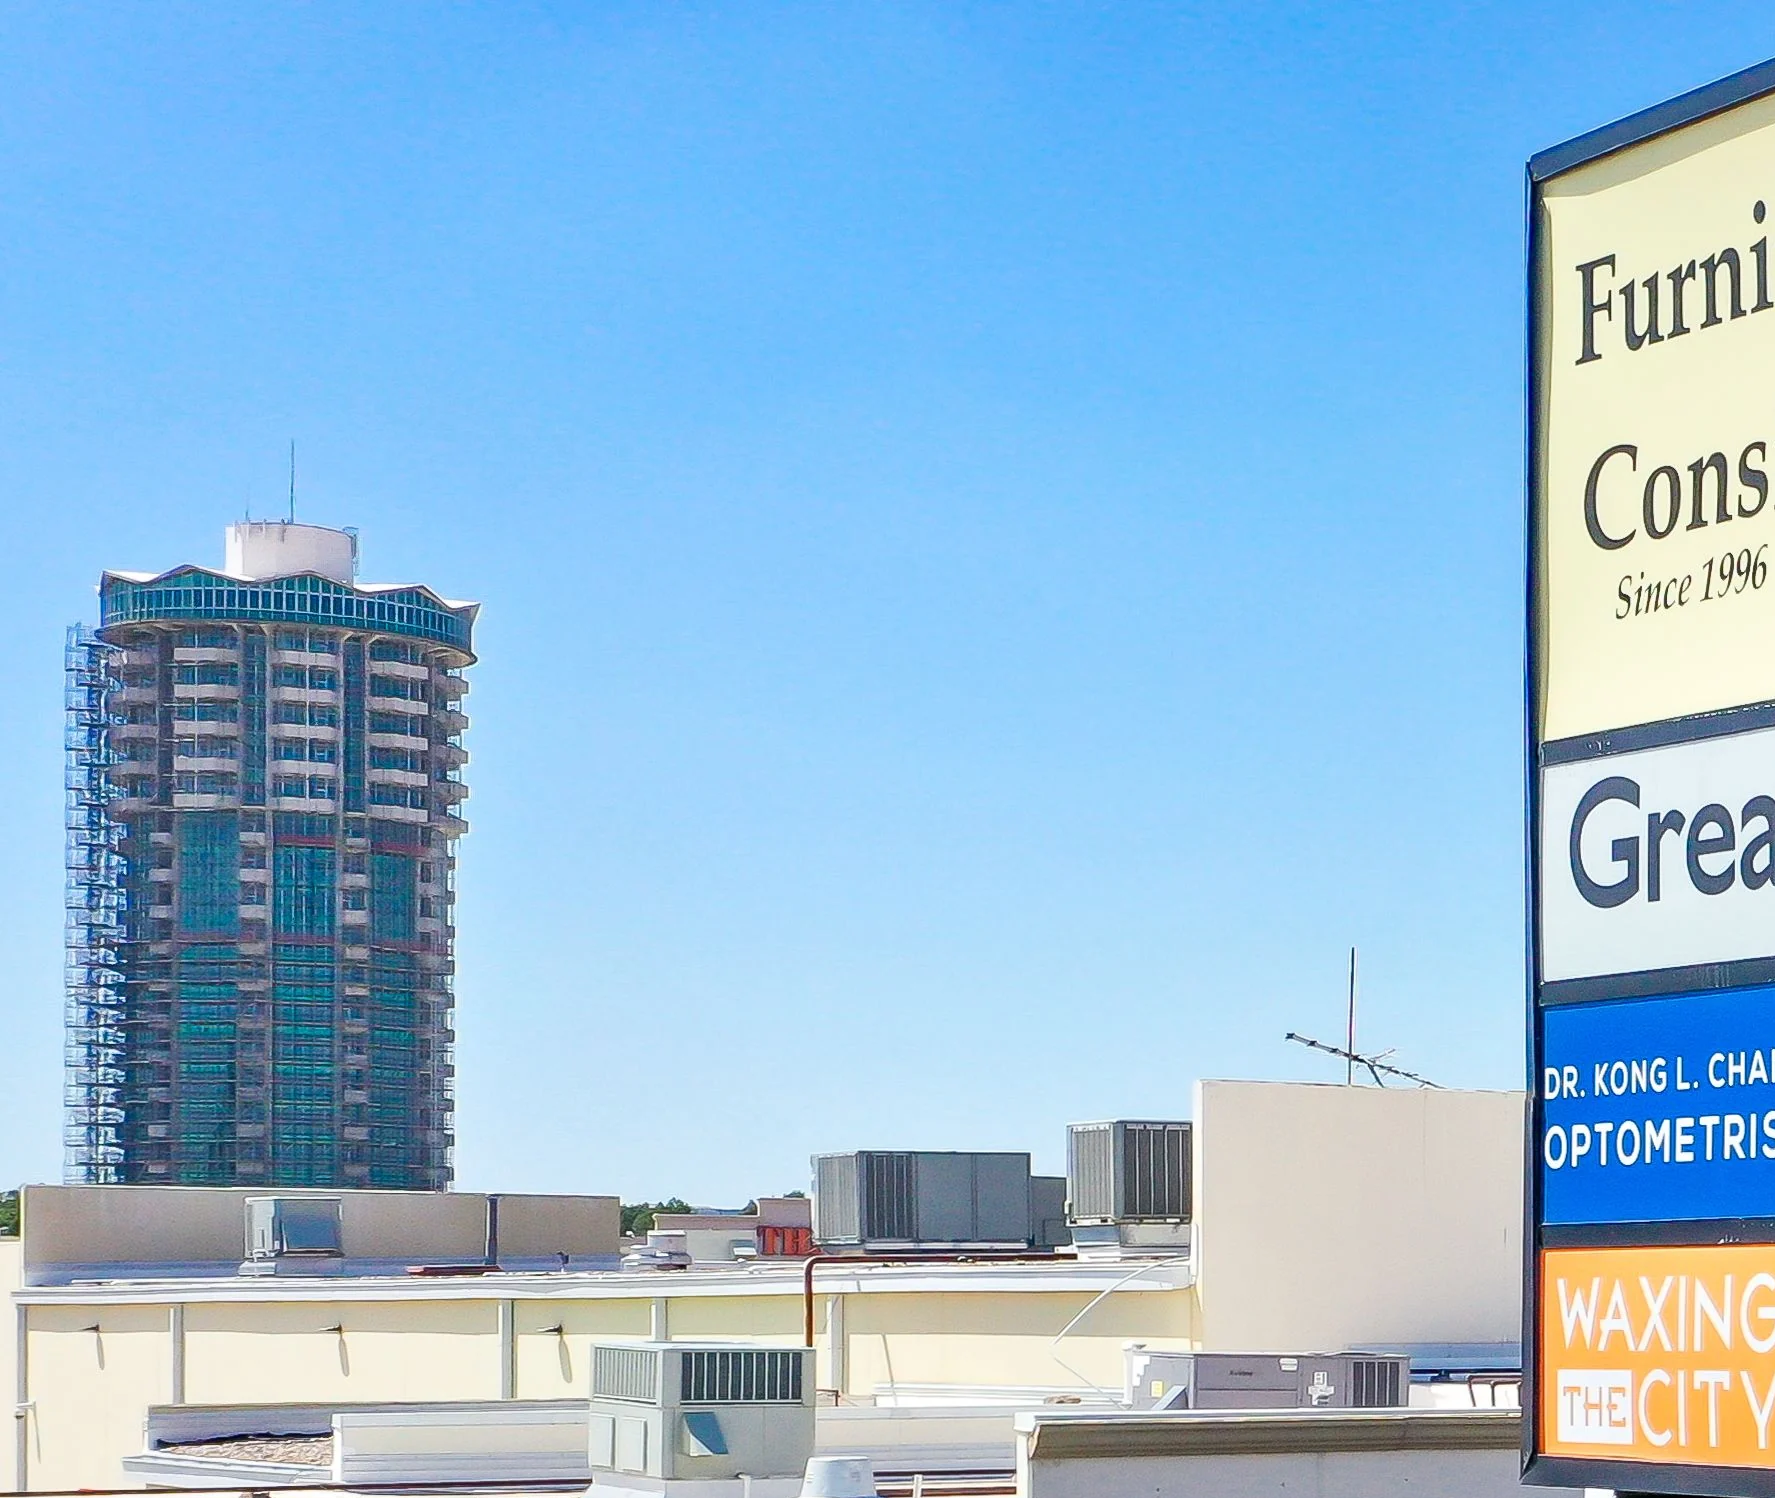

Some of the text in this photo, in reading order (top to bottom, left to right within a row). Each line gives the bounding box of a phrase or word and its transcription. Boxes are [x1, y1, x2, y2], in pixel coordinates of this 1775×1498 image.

[1615, 543, 1769, 620] Since 1996
[1544, 1065, 1585, 1100] DR.
[1594, 1057, 1667, 1098] KONG
[1676, 1054, 1699, 1091] L.
[1562, 1388, 1628, 1428] THE
